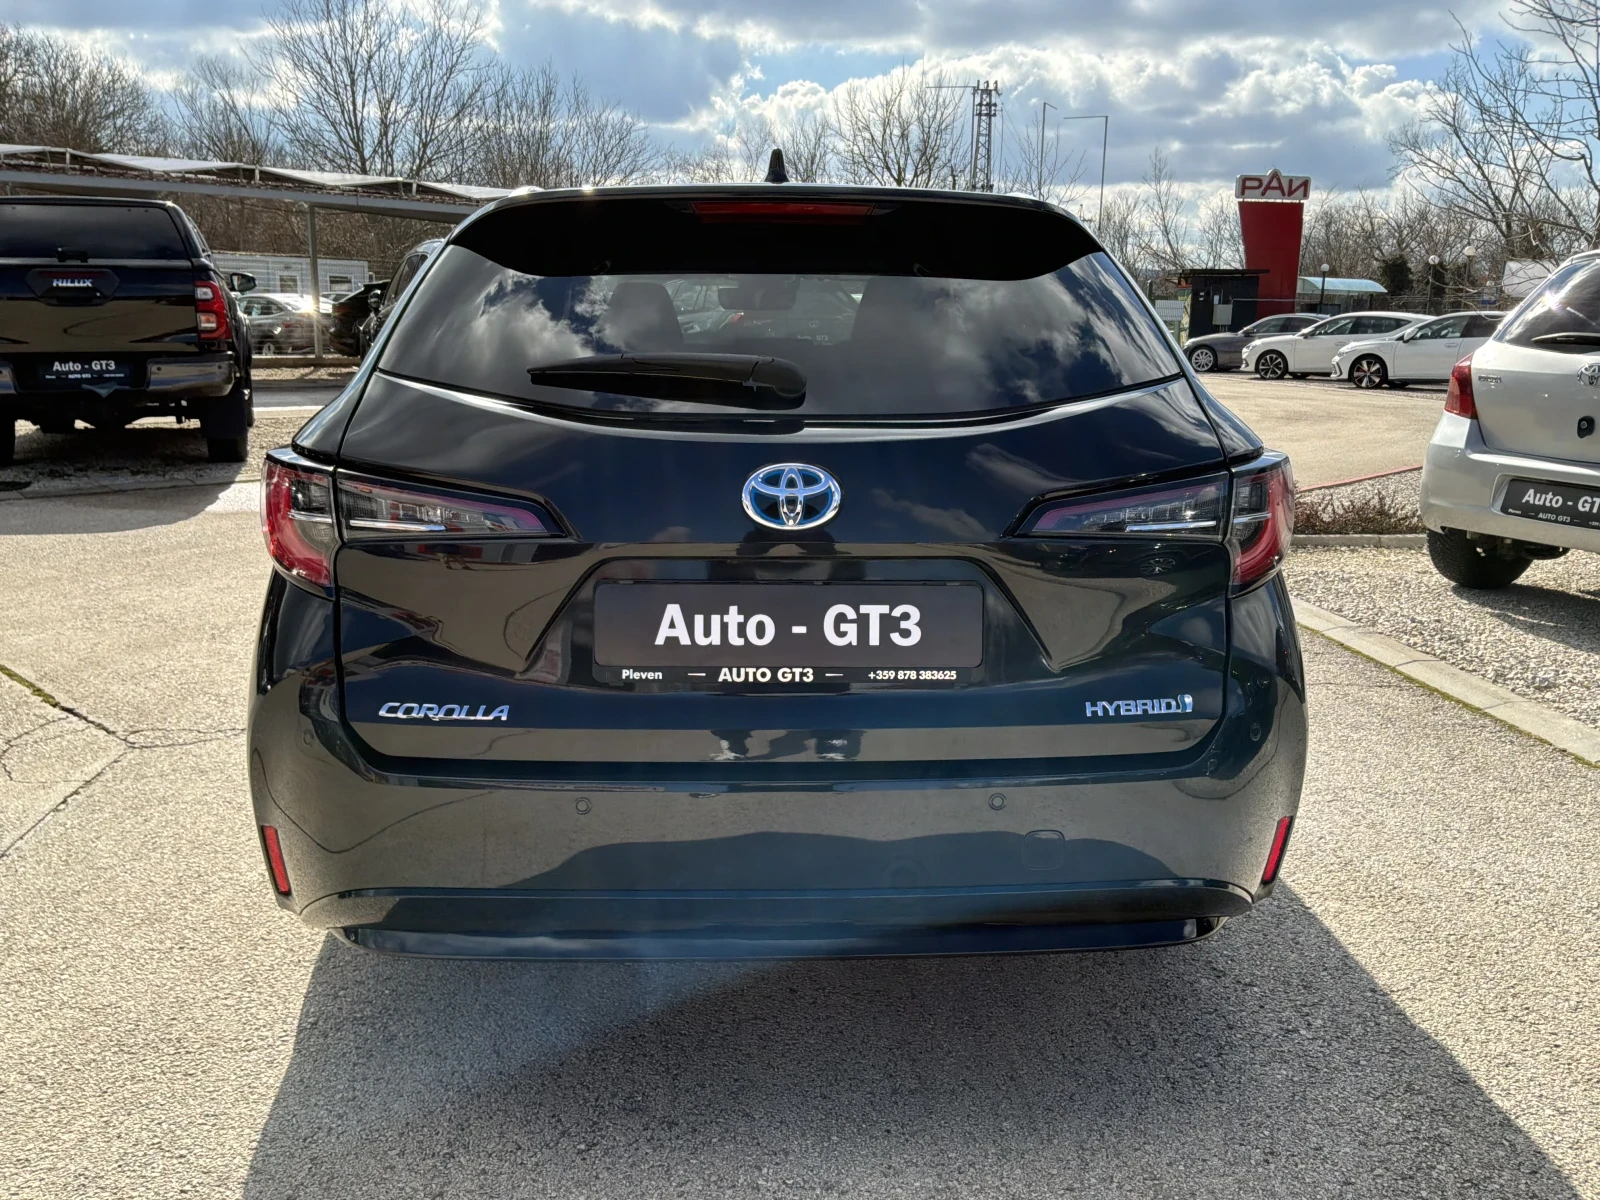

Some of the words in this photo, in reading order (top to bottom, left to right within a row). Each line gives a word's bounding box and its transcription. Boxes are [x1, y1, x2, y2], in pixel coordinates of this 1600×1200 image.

[52, 279, 93, 287] HILUX
[53, 361, 82, 372] Auto
[91, 360, 115, 371] GT3
[1522, 488, 1563, 508] Auto
[1538, 512, 1556, 520] AUTO
[1557, 515, 1571, 523] GT3
[655, 603, 776, 646] Auto
[823, 603, 922, 647] GT3
[621, 668, 663, 680] Pleven
[717, 667, 772, 683] AUTO
[777, 667, 814, 683] GT3
[867, 670, 896, 680] +359
[897, 670, 917, 680] 878
[918, 670, 957, 680] 383625
[378, 702, 510, 721] COROLLA
[1085, 698, 1178, 717] HYBRID
